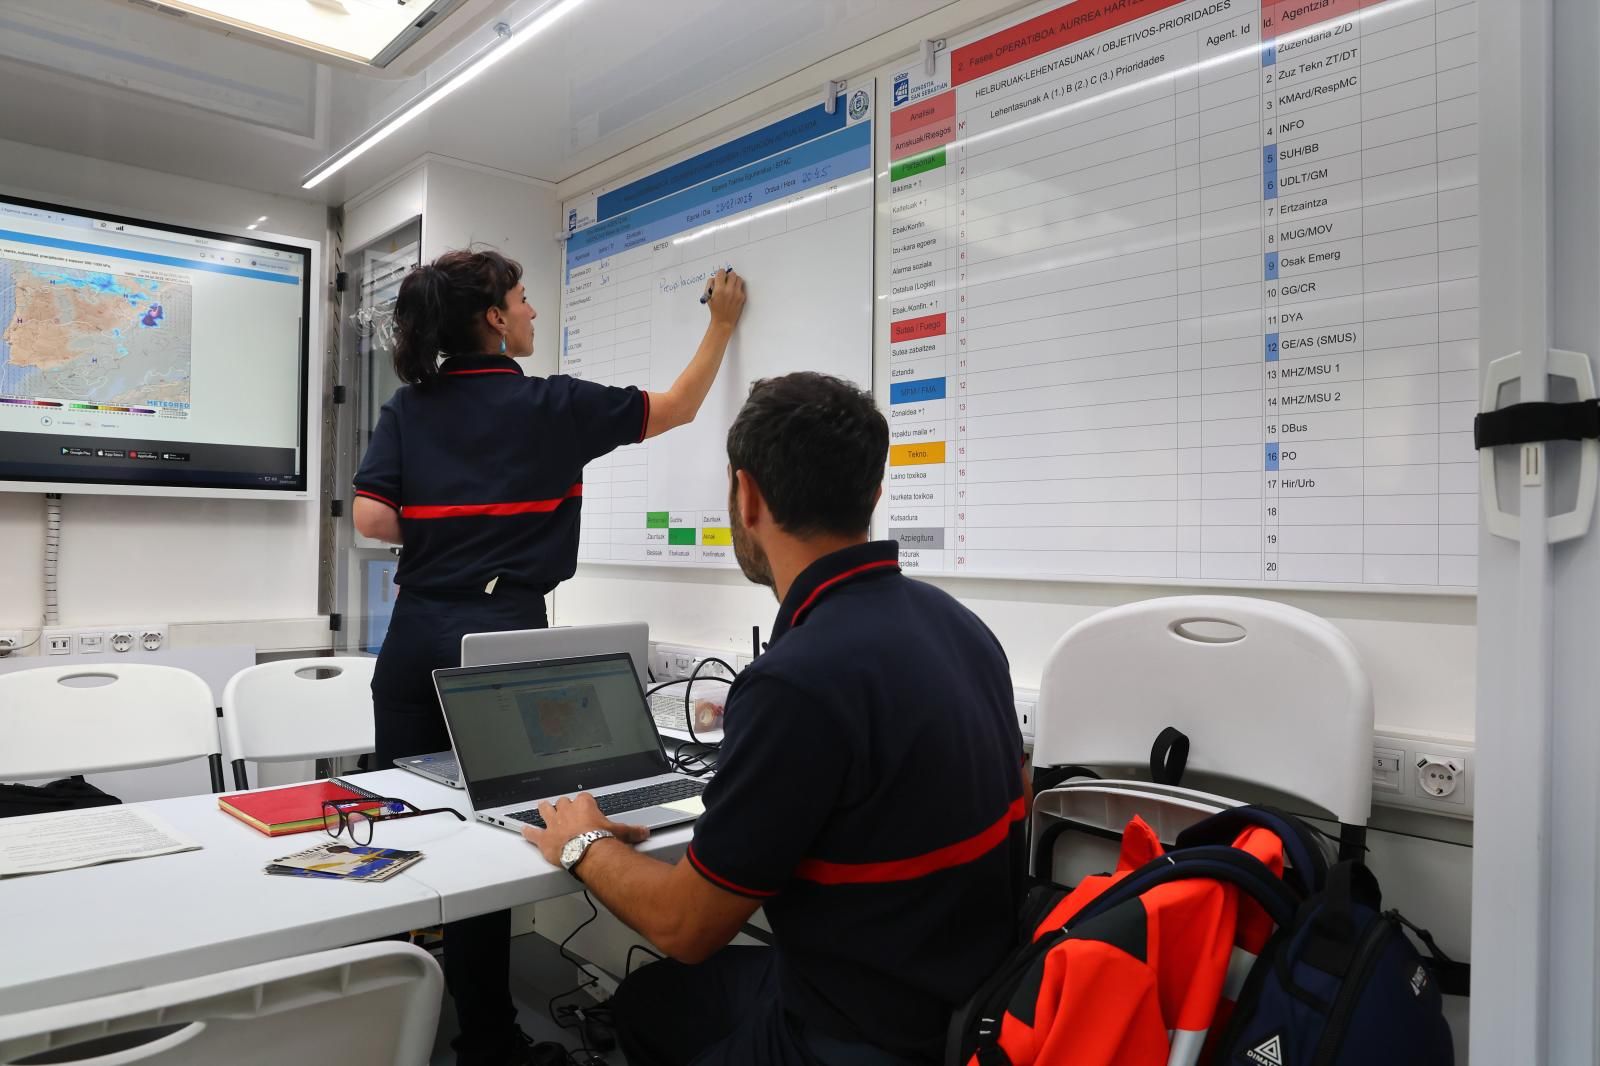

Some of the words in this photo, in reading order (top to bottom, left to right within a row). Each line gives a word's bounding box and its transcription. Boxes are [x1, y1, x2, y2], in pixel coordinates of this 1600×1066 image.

[1060, 9, 1101, 32] AURREA
[1104, 0, 1145, 16] HART
[1281, 0, 1329, 21] Agentzia
[1263, 17, 1274, 29] Id.
[1206, 29, 1238, 46] Agent.
[1241, 23, 1251, 35] Id
[1278, 31, 1332, 53] Zuzendaria
[1334, 23, 1353, 36] Z/D
[975, 49, 1095, 98] HELBURUAK-LEHENTASUNAK
[1102, 0, 1231, 52] OBJETIVOS-PRIORIDADES
[1266, 74, 1272, 84] 2
[1278, 68, 1296, 81] Zuz
[1299, 60, 1323, 74] Tekn
[1325, 48, 1358, 67] ZT/DT
[990, 95, 1041, 119] Lehentasunak
[1042, 92, 1050, 100] A
[1051, 88, 1065, 100] (1.)
[1066, 84, 1073, 93] B
[1074, 80, 1089, 92] (2.)
[1090, 76, 1098, 85] C
[1099, 72, 1114, 84] (3.)
[1116, 54, 1165, 77] Prioridades
[1266, 100, 1273, 110] 3
[1279, 76, 1357, 106] KMArd/RespMC
[1266, 127, 1273, 137] 4
[1279, 120, 1304, 134] INFO
[1267, 154, 1273, 164] 5
[1280, 143, 1319, 161] SUH/BB
[1267, 181, 1274, 190] 6
[1280, 168, 1328, 187] UDLT/GM
[1268, 208, 1274, 217] 7
[1280, 198, 1328, 214] Ertzaintza
[1268, 235, 1274, 244] 8
[1280, 224, 1333, 241] MUG/MOV
[1269, 261, 1275, 271] 9
[1281, 256, 1305, 268] Osak
[1308, 250, 1341, 264] Emerg
[892, 265, 911, 274] Alarma
[1267, 288, 1277, 298] 10
[1281, 282, 1316, 296] GG/CR
[919, 320, 941, 330] Fuego
[1268, 315, 1277, 325] 11
[1281, 312, 1303, 324] DYA
[1268, 343, 1277, 352] 12
[1281, 337, 1314, 350] GE/AS
[1316, 332, 1357, 348] (SMUS)
[1267, 370, 1277, 380] 13
[1281, 364, 1332, 378] MHZ/MSU
[1335, 363, 1340, 373] 1
[1268, 397, 1277, 407] 14
[1281, 393, 1332, 406] MHZ/MSU
[1334, 392, 1341, 401] 2
[1267, 425, 1277, 434] 15
[1281, 423, 1308, 433] DBus
[908, 450, 927, 458] Tekno
[1268, 452, 1277, 461] 16
[1281, 451, 1297, 461] PO
[1267, 480, 1277, 489] 17
[1281, 479, 1315, 489] Hir/Urb
[1267, 507, 1277, 516] 18
[1267, 535, 1277, 544] 19
[1266, 562, 1277, 571] 20
